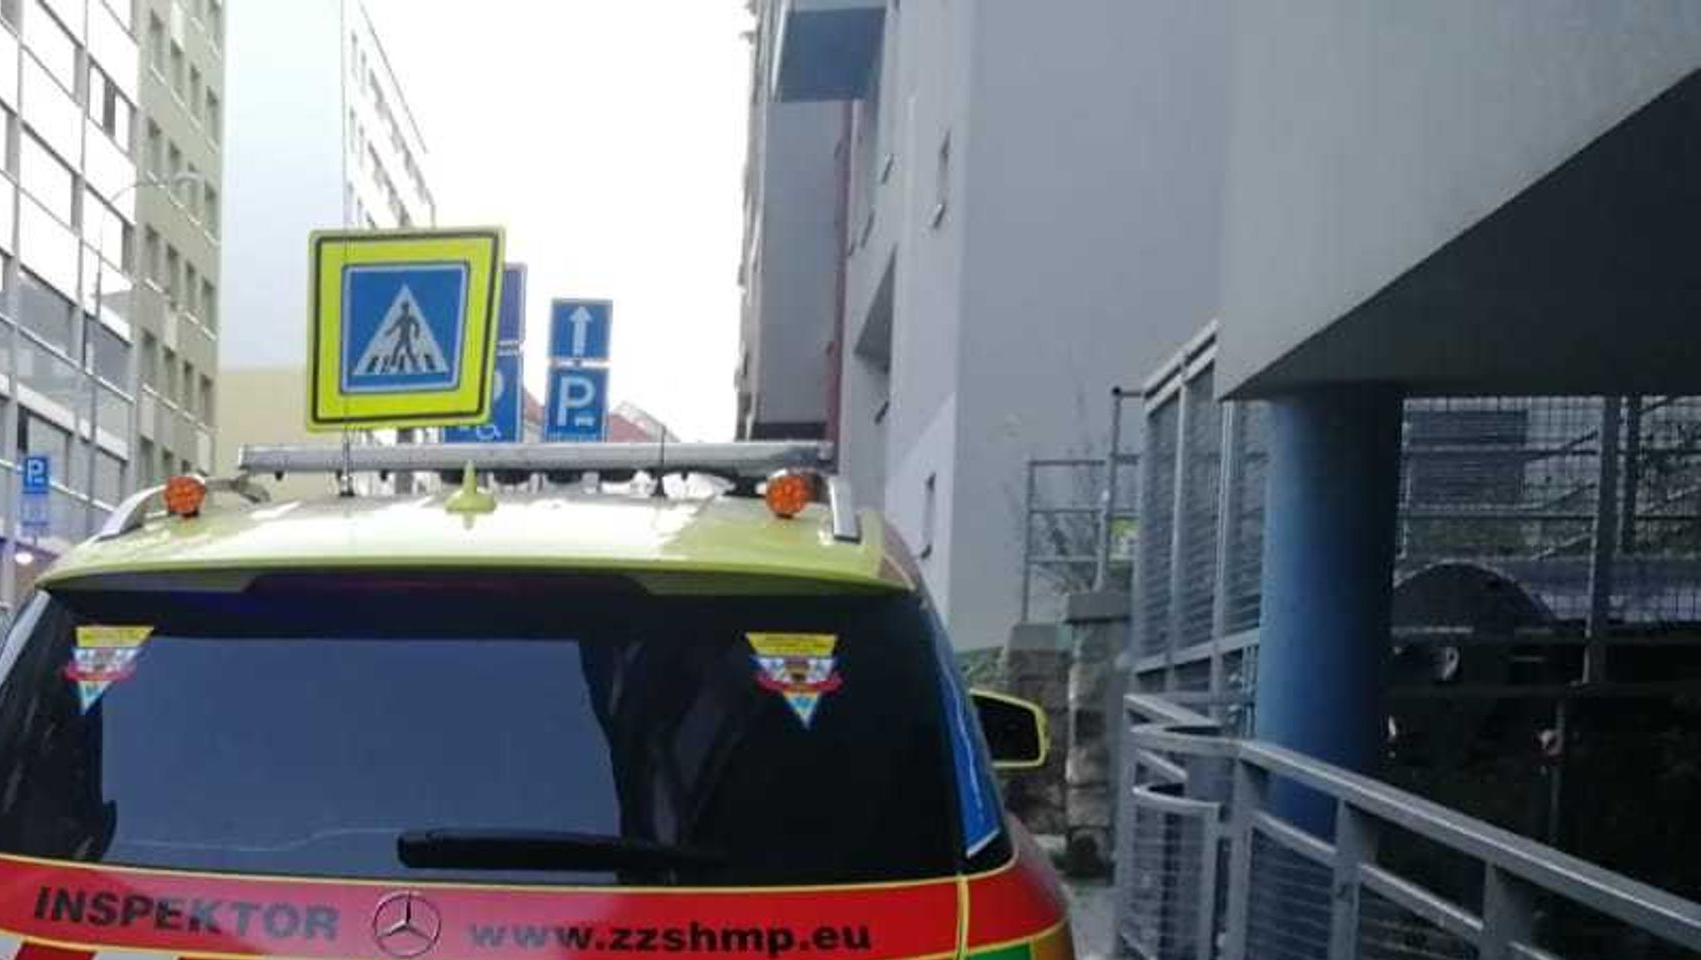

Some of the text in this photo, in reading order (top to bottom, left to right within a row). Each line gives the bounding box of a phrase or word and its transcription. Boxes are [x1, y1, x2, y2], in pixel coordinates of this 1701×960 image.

[557, 375, 595, 427] P
[27, 459, 44, 485] P
[34, 885, 340, 941] INSPEKTOR
[469, 921, 871, 958] www.zzshmp.eu
